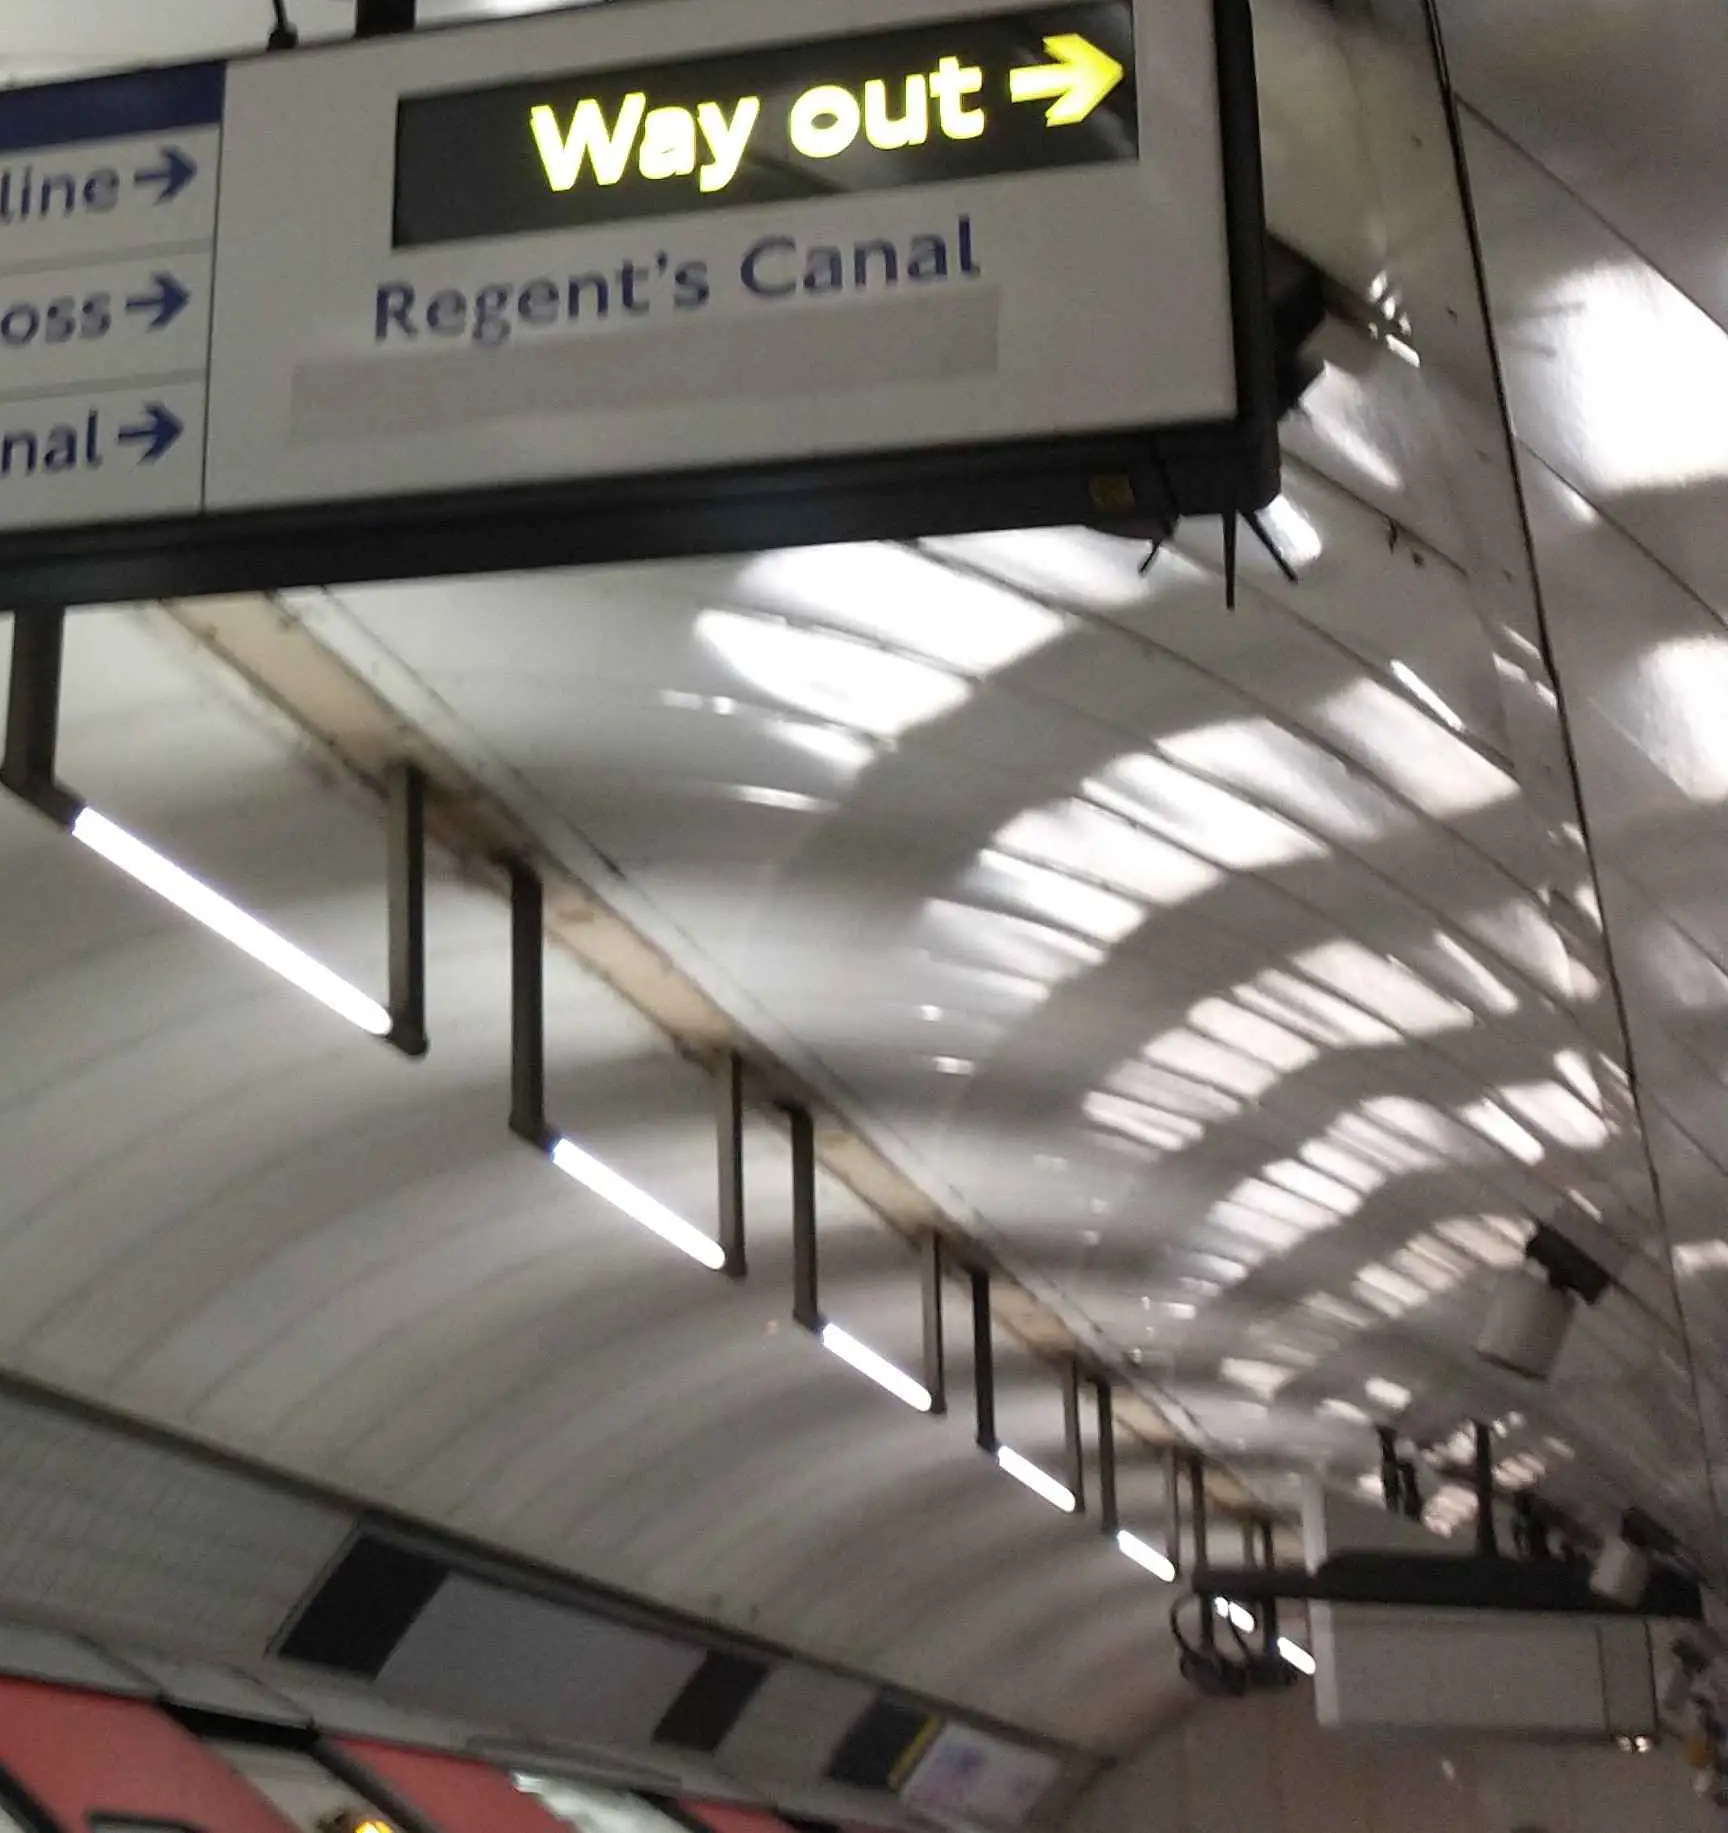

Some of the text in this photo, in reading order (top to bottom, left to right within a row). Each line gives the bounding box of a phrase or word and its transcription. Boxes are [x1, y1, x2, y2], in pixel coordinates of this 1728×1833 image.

[531, 55, 986, 192] Way out
[375, 214, 981, 345] Regent's Canal
